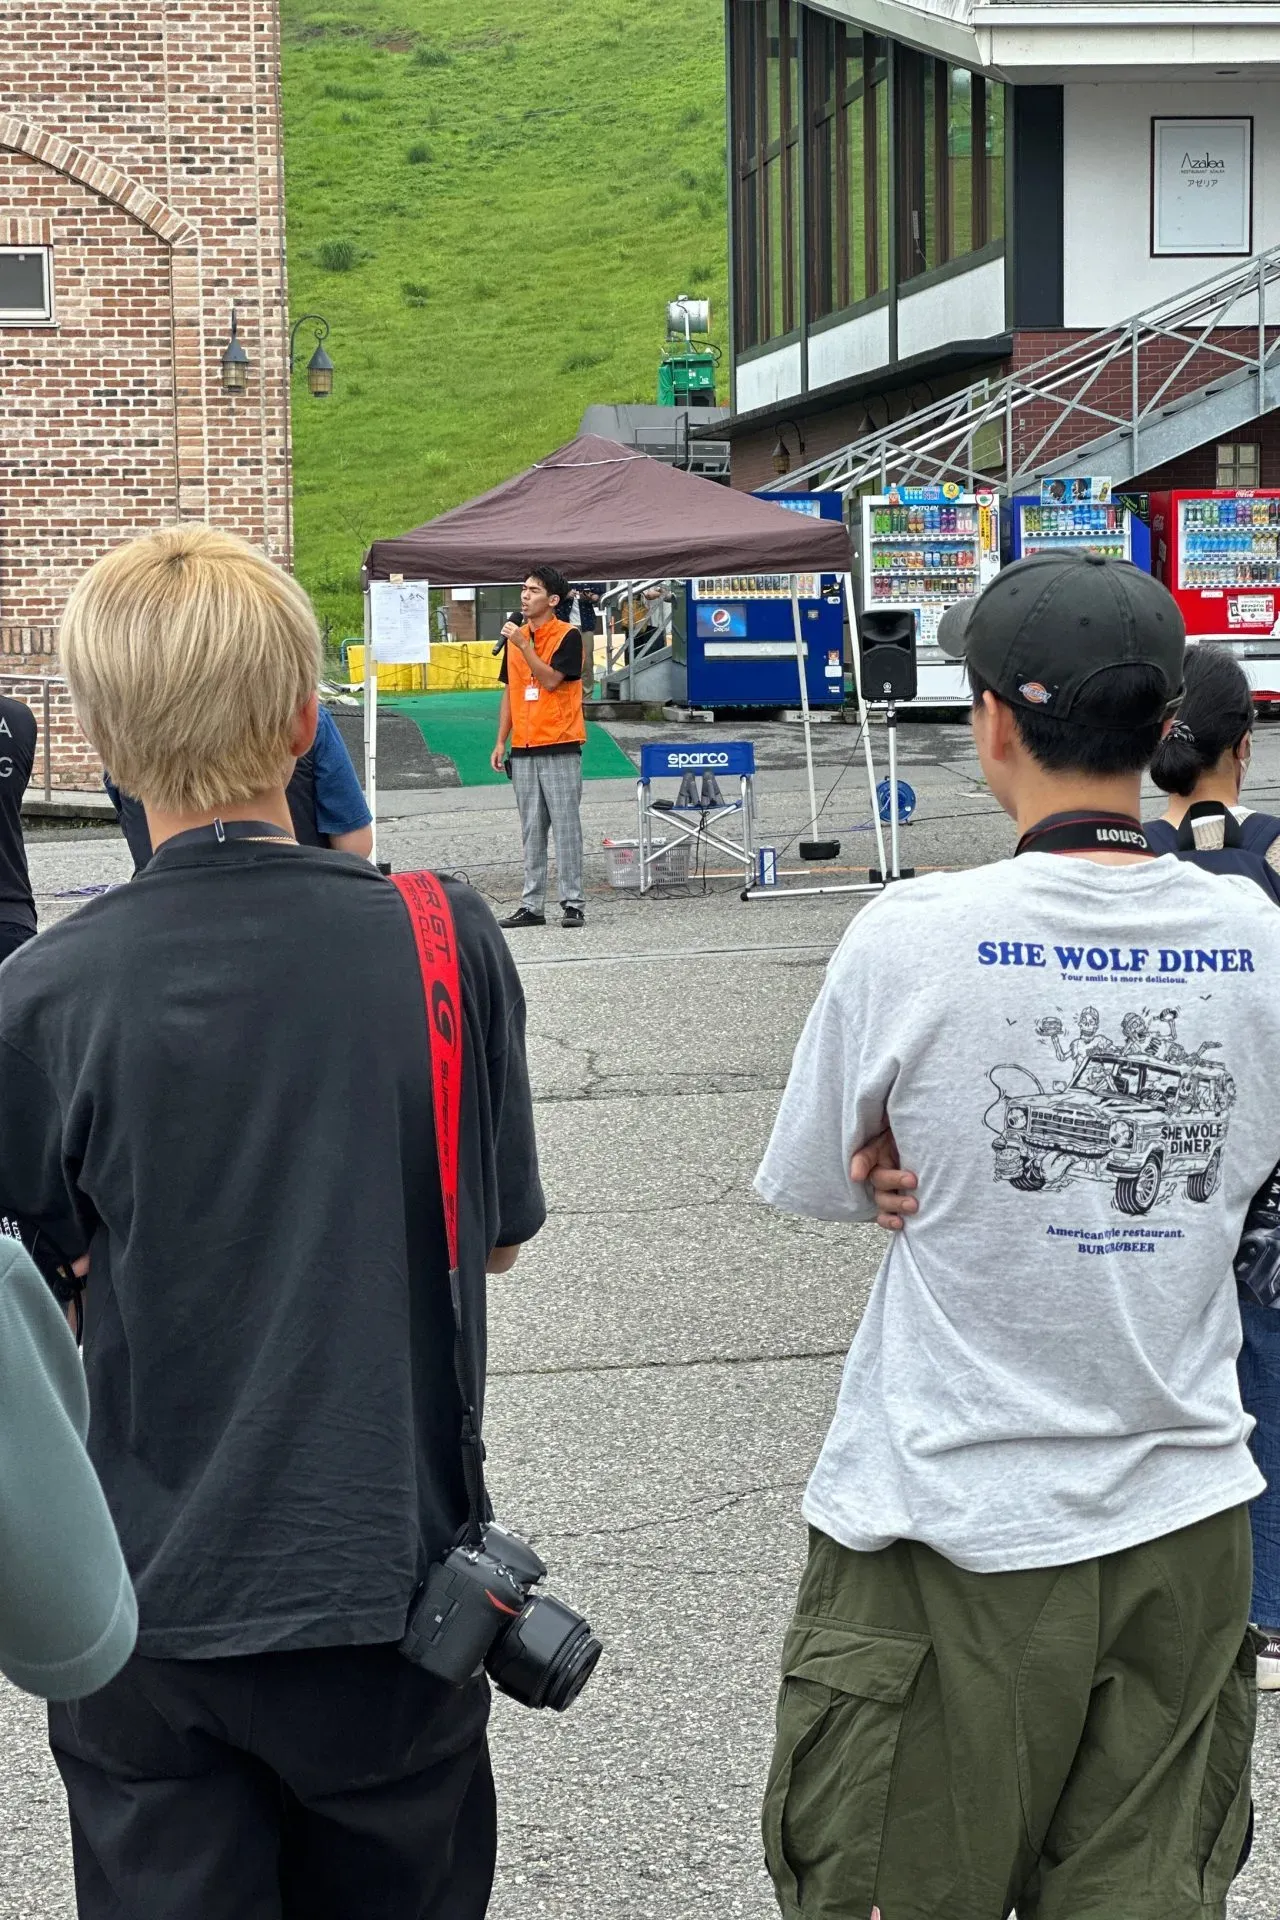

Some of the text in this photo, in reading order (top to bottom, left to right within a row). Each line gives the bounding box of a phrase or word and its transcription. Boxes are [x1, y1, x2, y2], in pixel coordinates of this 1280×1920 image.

[1181, 152, 1224, 168] Azalea
[1187, 179, 1219, 188] アゼリア
[0, 716, 13, 738] A
[0, 756, 13, 778] G
[667, 752, 729, 769] sparco
[1096, 828, 1148, 849] Canon
[418, 915, 435, 963] CLUB
[430, 913, 452, 964] GT
[977, 941, 1256, 973] SHE WOLF DINER
[1060, 972, 1083, 982] Your
[1110, 974, 1118, 983] is
[1145, 976, 1188, 984] delicious.
[441, 1060, 449, 1138] SUPER
[1161, 1123, 1223, 1140] SHE WOLF
[1170, 1139, 1212, 1154] DINER
[1046, 1225, 1104, 1240] American
[1122, 1228, 1185, 1238] restaurant.
